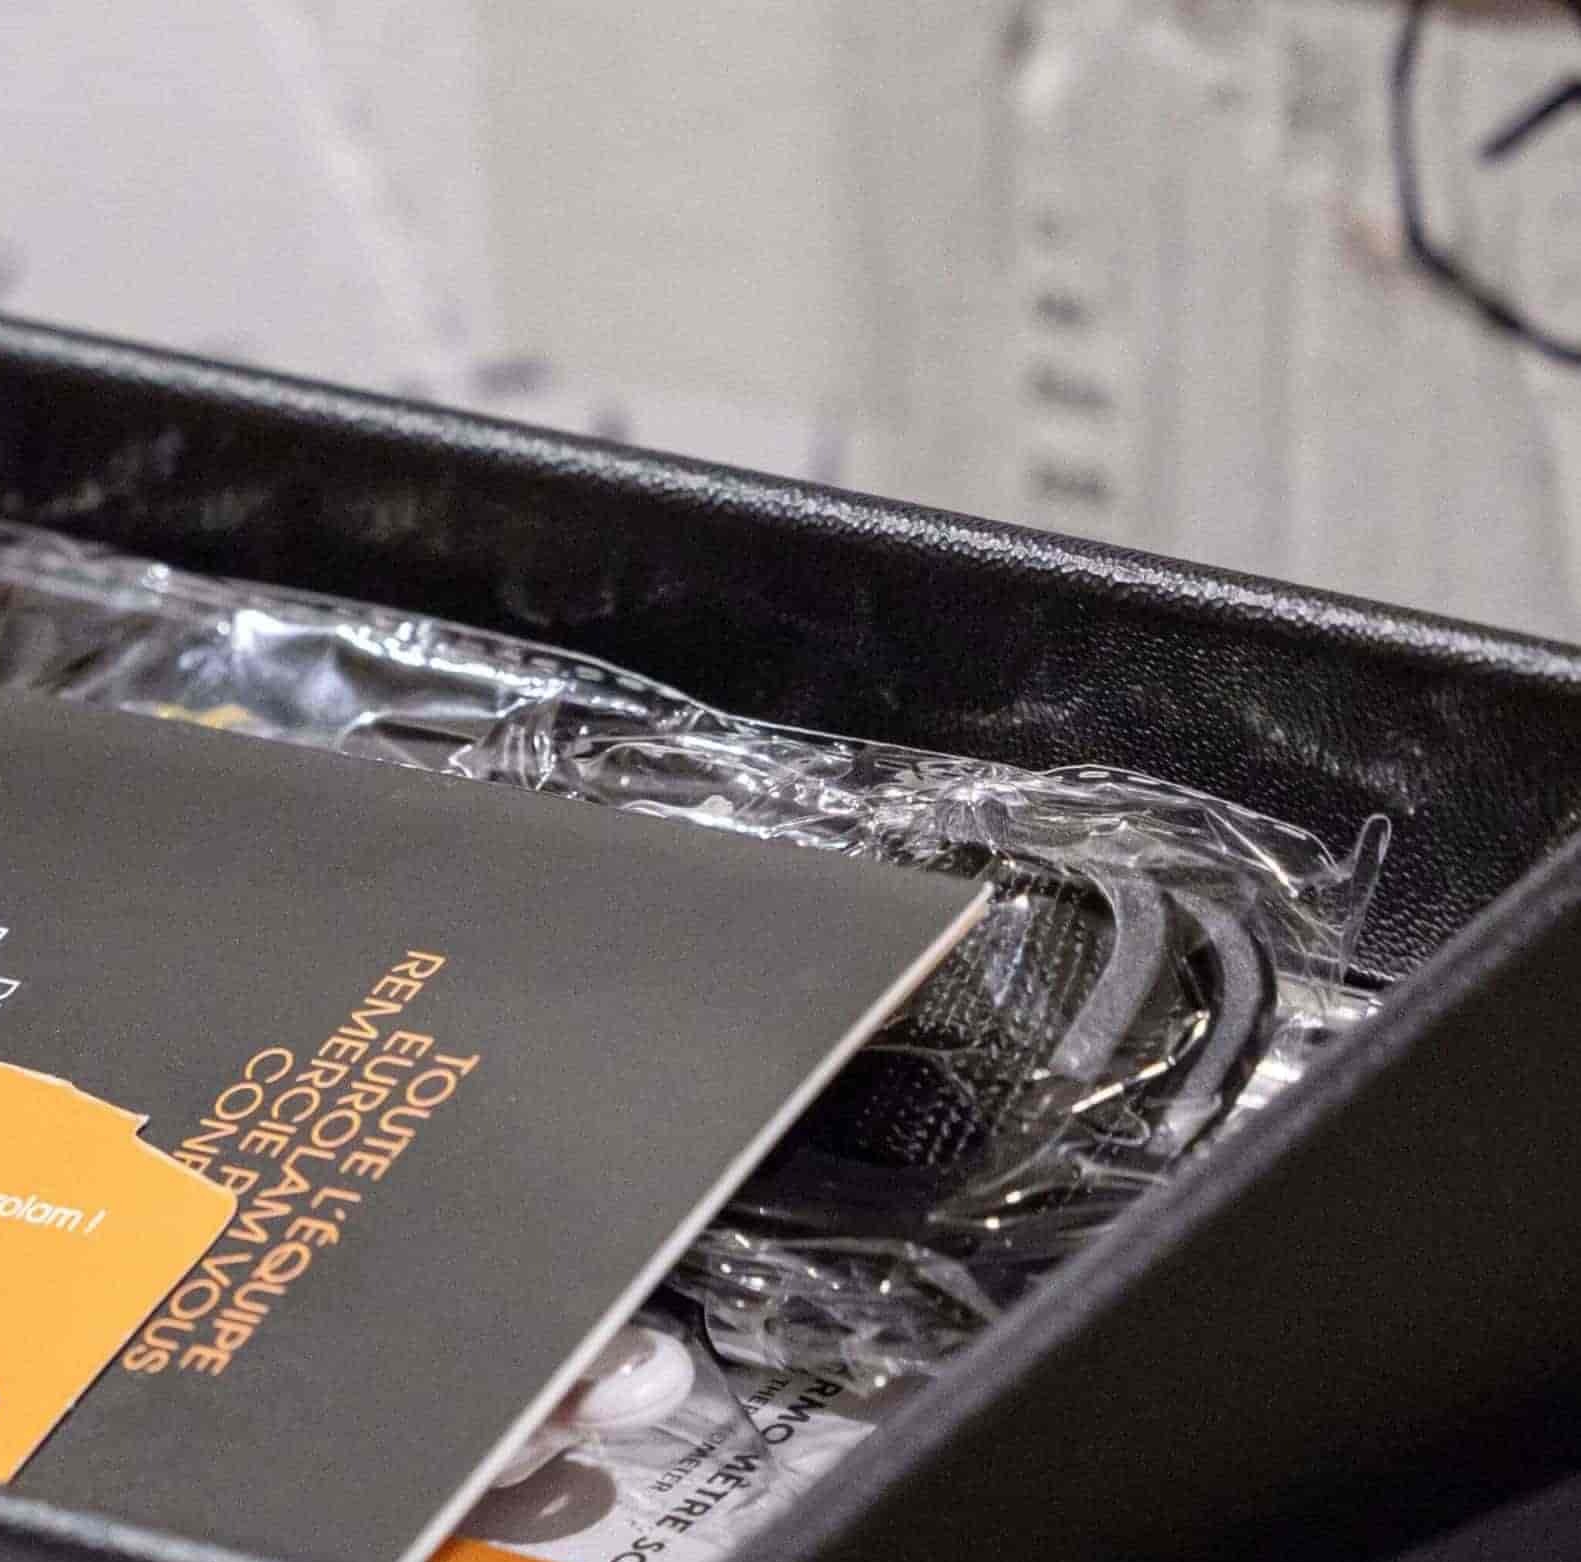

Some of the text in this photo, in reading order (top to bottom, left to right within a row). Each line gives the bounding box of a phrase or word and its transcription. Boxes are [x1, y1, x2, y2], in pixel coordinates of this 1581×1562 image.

[239, 950, 447, 1158] REMERCIE
[85, 1209, 106, 1233] !
[123, 1030, 434, 1373] EUROLAM VOUS
[179, 1053, 480, 1376] TOUTE L'ÉQUIPE
